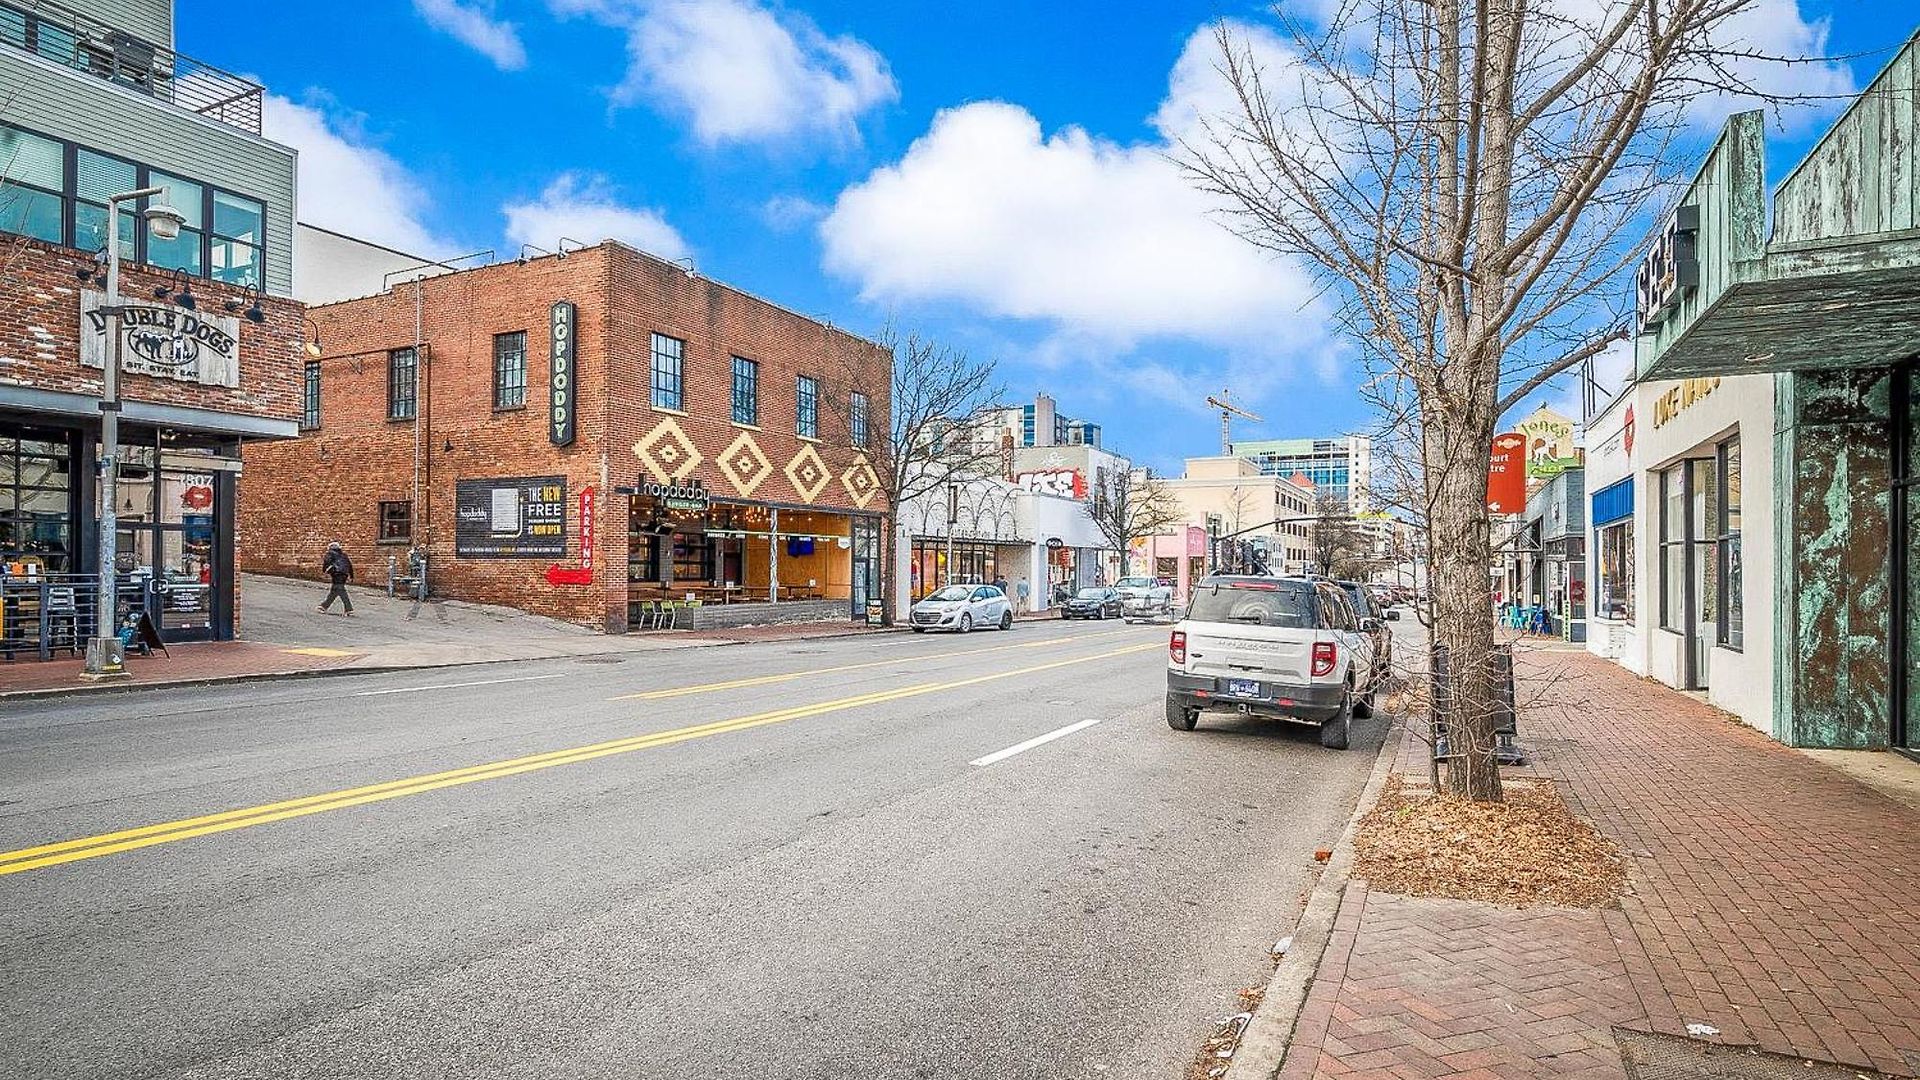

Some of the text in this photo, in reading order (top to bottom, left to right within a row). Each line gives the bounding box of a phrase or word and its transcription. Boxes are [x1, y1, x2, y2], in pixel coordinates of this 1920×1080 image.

[86, 306, 235, 353] DUBLE DOGS
[553, 307, 568, 440] HOPDODDY
[528, 486, 561, 502] THE NEW
[528, 504, 562, 516] FREE
[583, 495, 592, 569] PARKING
